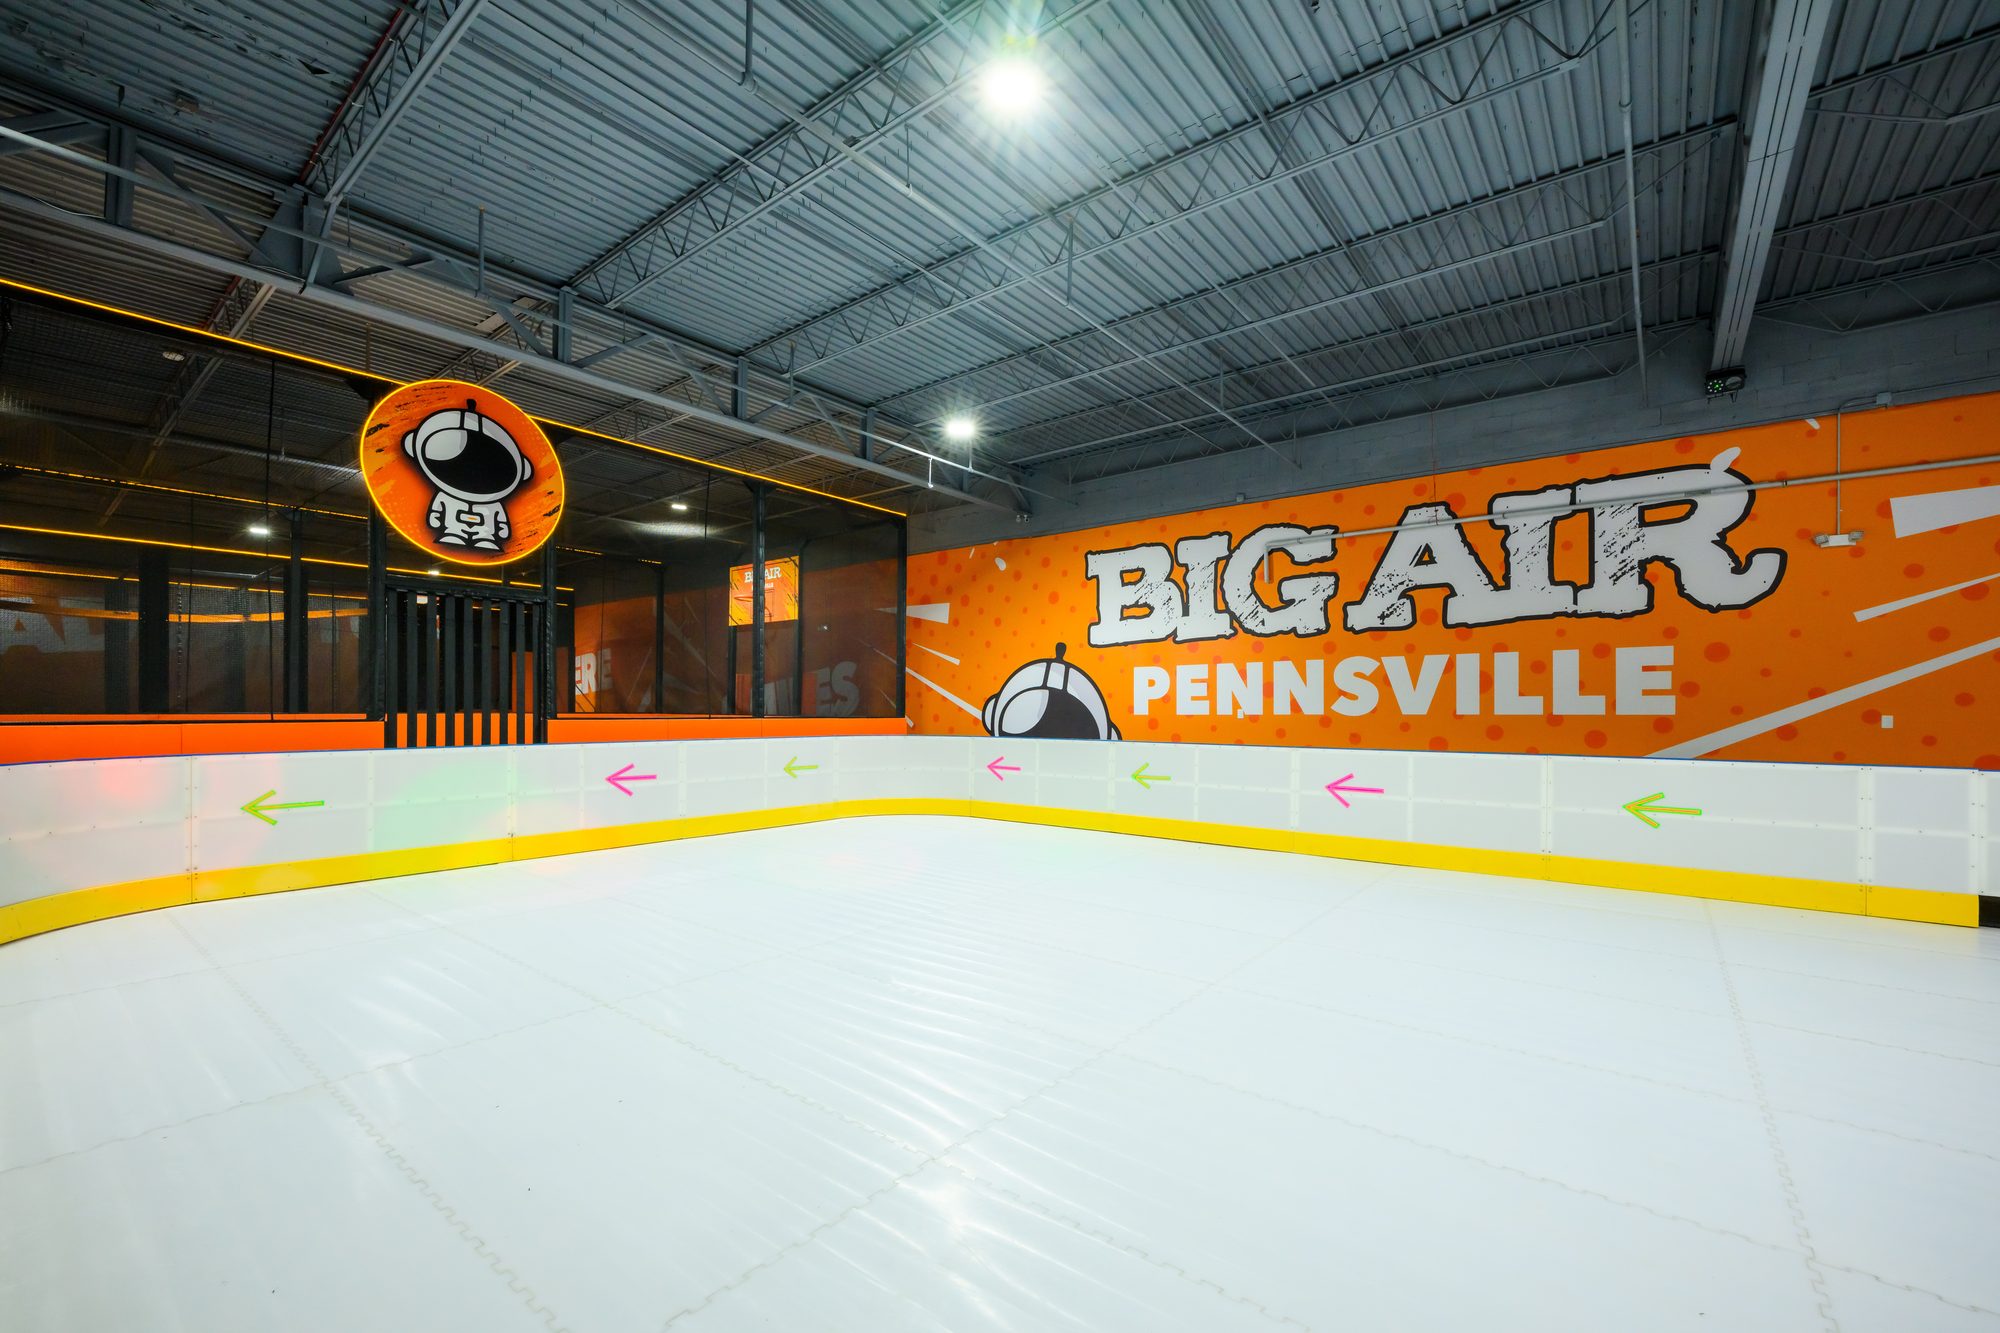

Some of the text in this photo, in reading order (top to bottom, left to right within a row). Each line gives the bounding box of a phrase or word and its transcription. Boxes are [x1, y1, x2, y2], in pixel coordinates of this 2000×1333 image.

[1085, 447, 1787, 646] BIG AIR
[1132, 646, 1676, 715] PENNSVILLE
